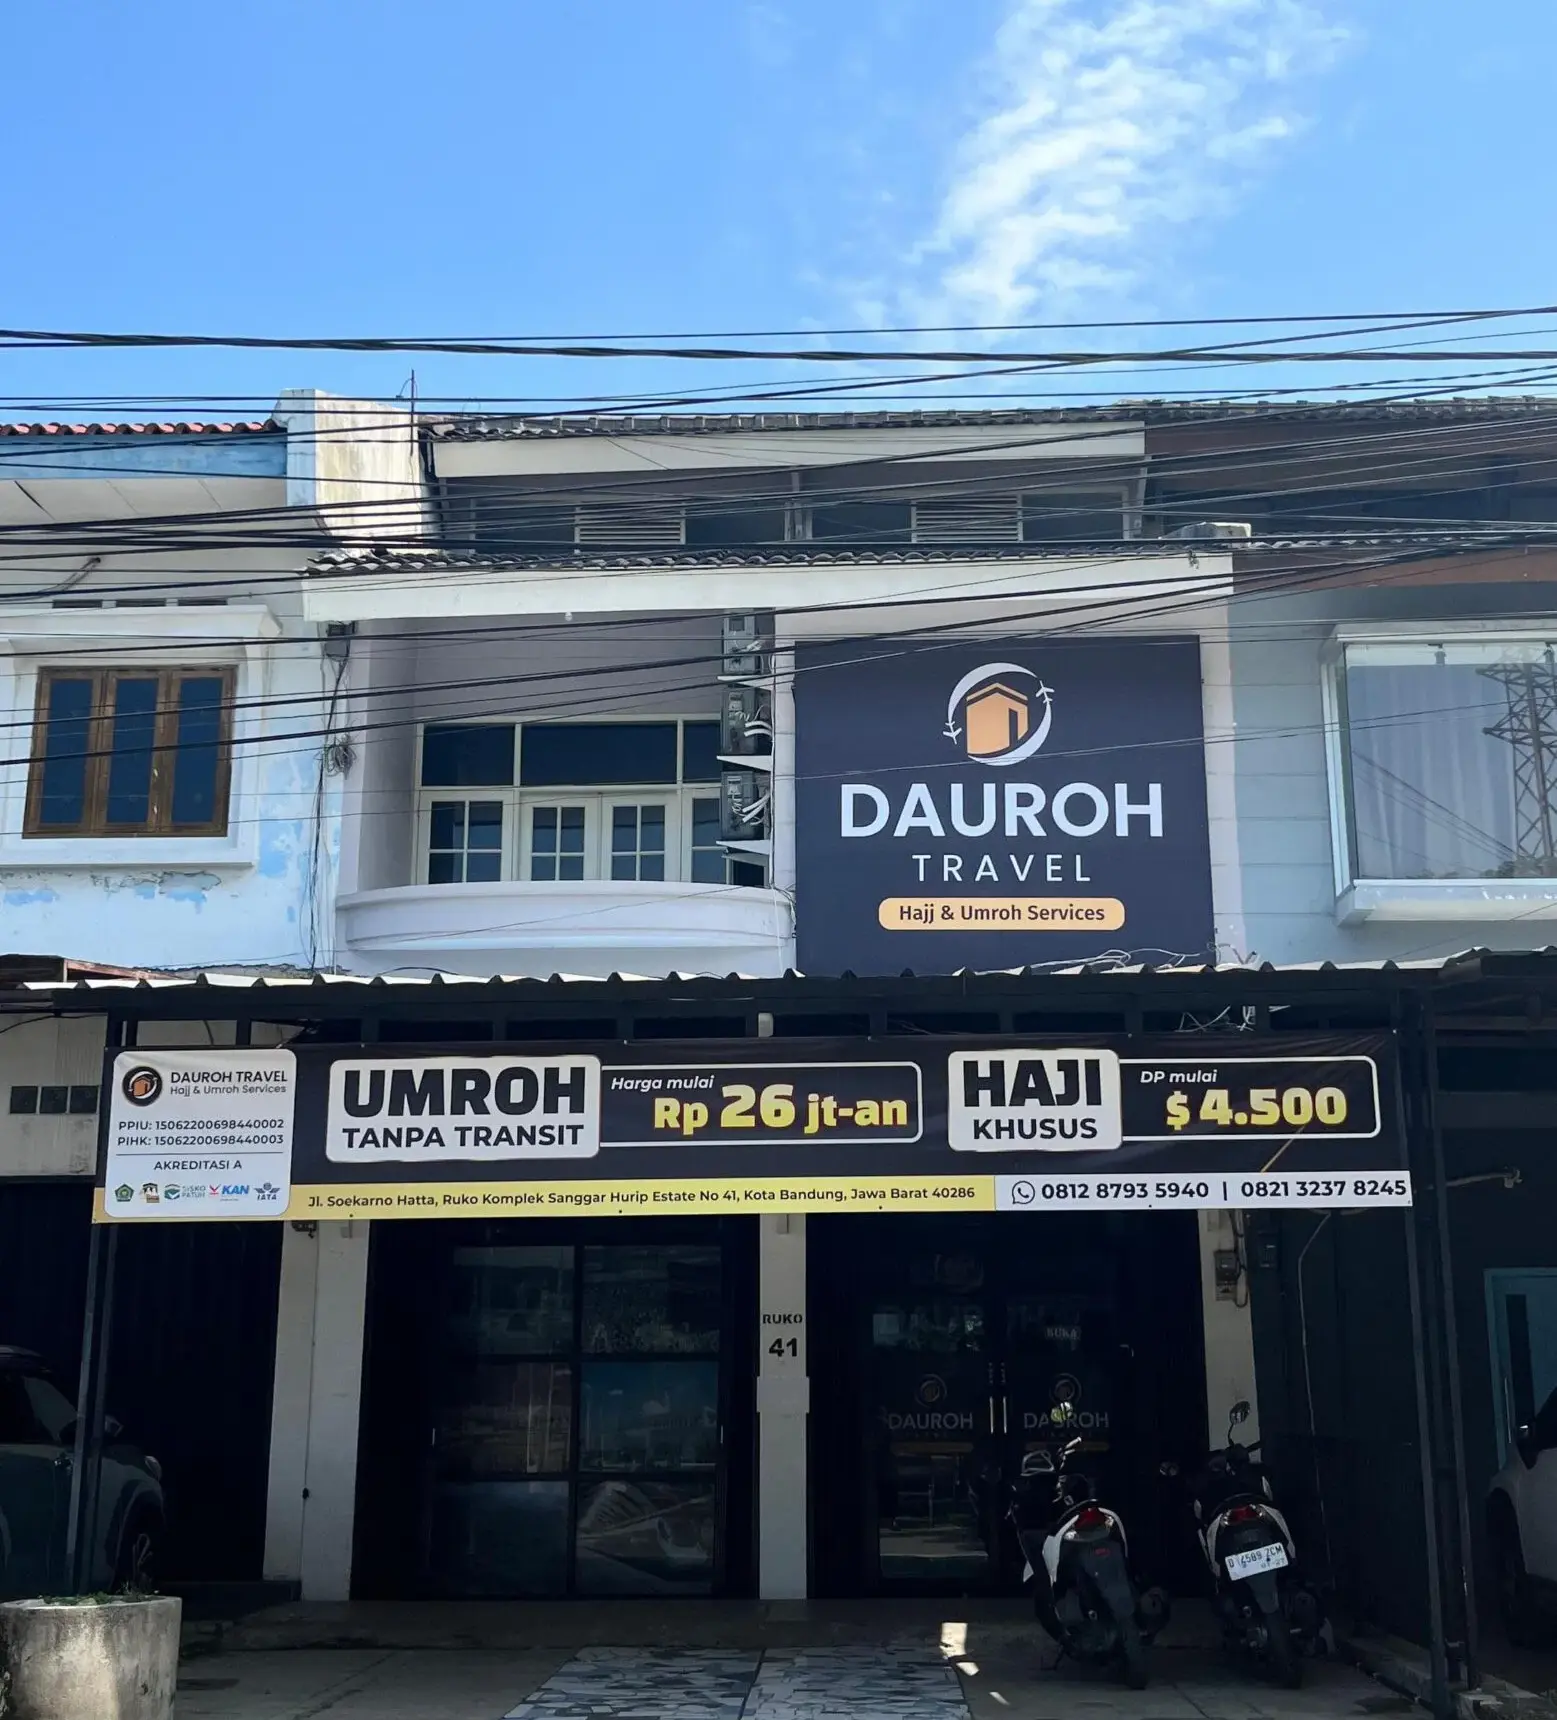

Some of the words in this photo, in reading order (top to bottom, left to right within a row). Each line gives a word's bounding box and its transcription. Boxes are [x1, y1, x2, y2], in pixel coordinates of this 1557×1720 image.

[840, 782, 1163, 838] DAUROH
[912, 854, 1091, 882] TRAVEL
[899, 905, 935, 925] Hajj
[941, 905, 955, 921] &
[961, 904, 1022, 921] Umroh
[1028, 904, 1105, 921] Services
[171, 1071, 232, 1083] DAUROH
[235, 1070, 288, 1082] TRAVEL
[610, 1076, 662, 1093] Harga
[667, 1075, 714, 1089] mulai
[963, 1058, 1102, 1107] HAJI
[1140, 1070, 1165, 1084] DP
[1169, 1068, 1218, 1083] mulai
[170, 1086, 191, 1097] Hajj
[193, 1086, 201, 1094] &
[204, 1085, 239, 1094] Umroh
[242, 1084, 287, 1094] Services
[344, 1067, 585, 1117] UMROH
[653, 1096, 709, 1135] Rp
[720, 1084, 796, 1129] 26
[804, 1093, 908, 1134] jt-an
[1166, 1090, 1190, 1131] $
[1199, 1086, 1347, 1126] 4.500
[119, 1120, 152, 1130] PPIU:
[155, 1119, 284, 1130] 15062200698440002
[973, 1118, 1098, 1140] KHUSUS
[118, 1136, 151, 1146] PIHK:
[155, 1135, 284, 1146] 15062200698440003
[343, 1126, 445, 1148] TANPA
[455, 1124, 584, 1147] TRANSIT
[154, 1160, 230, 1170] AKREDITASI
[232, 1160, 242, 1170] A
[222, 1185, 249, 1195] KAN
[308, 1196, 323, 1207] Jl.
[327, 1195, 393, 1207] Soekarno
[397, 1194, 438, 1207] Hatta,
[443, 1194, 478, 1205] Ruko
[483, 1193, 544, 1206] Komplek
[548, 1192, 605, 1206] Sanggar
[610, 1190, 649, 1204] Hurip
[652, 1190, 696, 1202] Estate
[700, 1190, 719, 1202] No
[723, 1190, 740, 1203] 41,
[744, 1190, 775, 1201] Kota
[780, 1188, 847, 1202] Bandung,
[851, 1188, 886, 1199] Jawa
[891, 1188, 928, 1199] Barat
[932, 1187, 975, 1198] 40286
[1041, 1182, 1090, 1200] 0812
[1096, 1182, 1148, 1199] 8793
[1155, 1181, 1209, 1199] 5940
[1241, 1180, 1289, 1198] 0821
[1295, 1180, 1346, 1198] 3237
[1353, 1180, 1407, 1197] 8245
[763, 1314, 803, 1324] RUKO
[768, 1337, 798, 1357] 41
[888, 1413, 974, 1430] DAUROH
